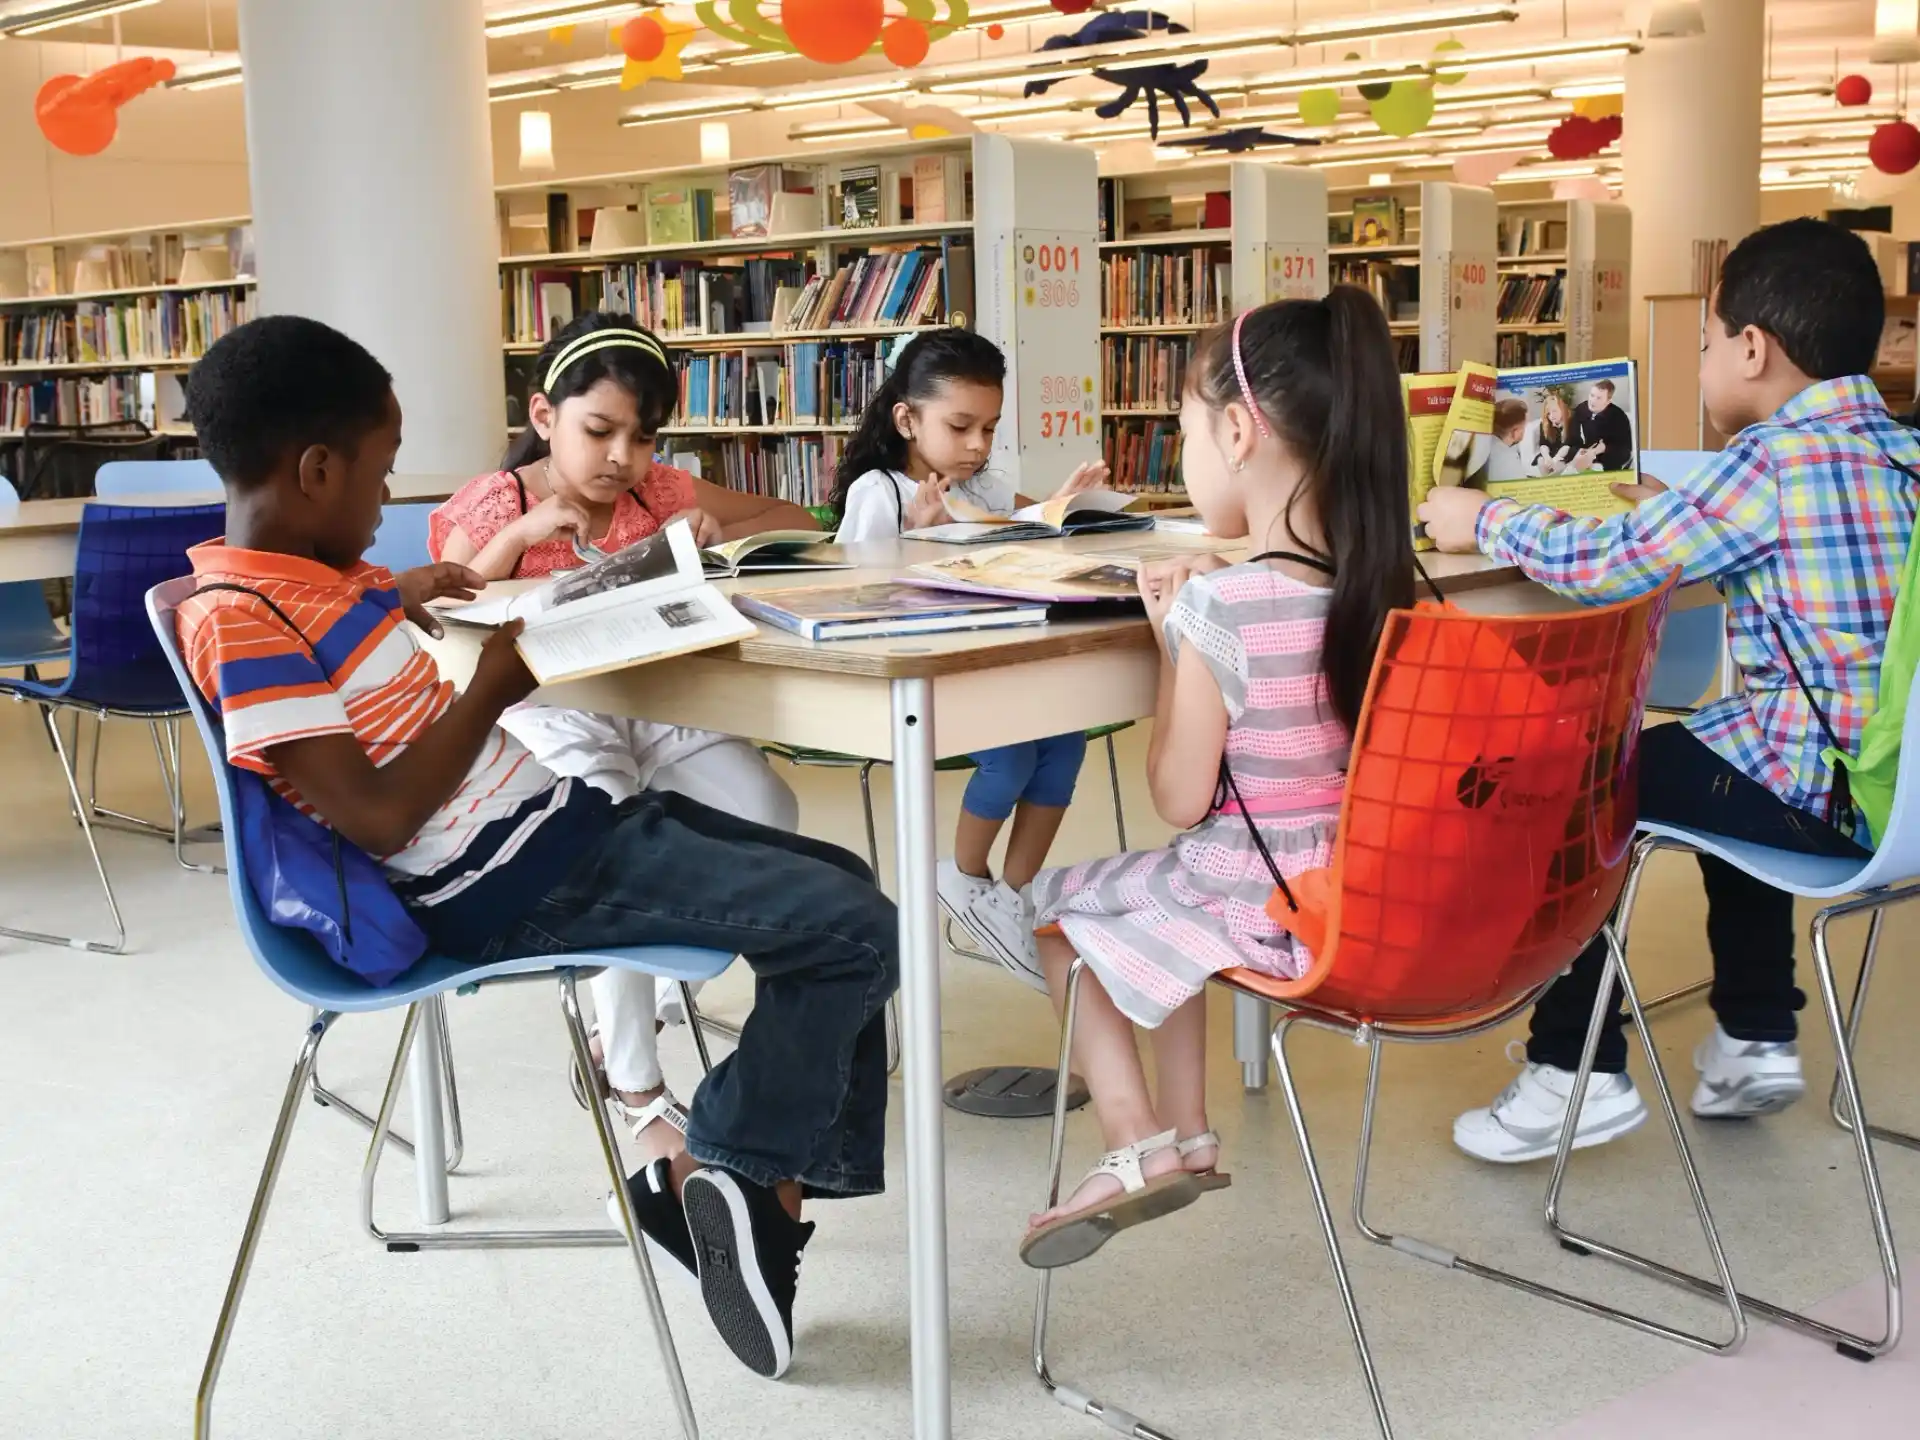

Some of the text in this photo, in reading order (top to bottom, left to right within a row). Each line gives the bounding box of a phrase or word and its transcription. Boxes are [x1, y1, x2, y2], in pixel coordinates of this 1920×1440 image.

[1039, 244, 1079, 273] 001
[1284, 255, 1314, 279] 371
[1462, 263, 1486, 285] 400
[1040, 279, 1080, 307] 306
[1040, 376, 1081, 404] 306
[1040, 411, 1080, 438] 371
